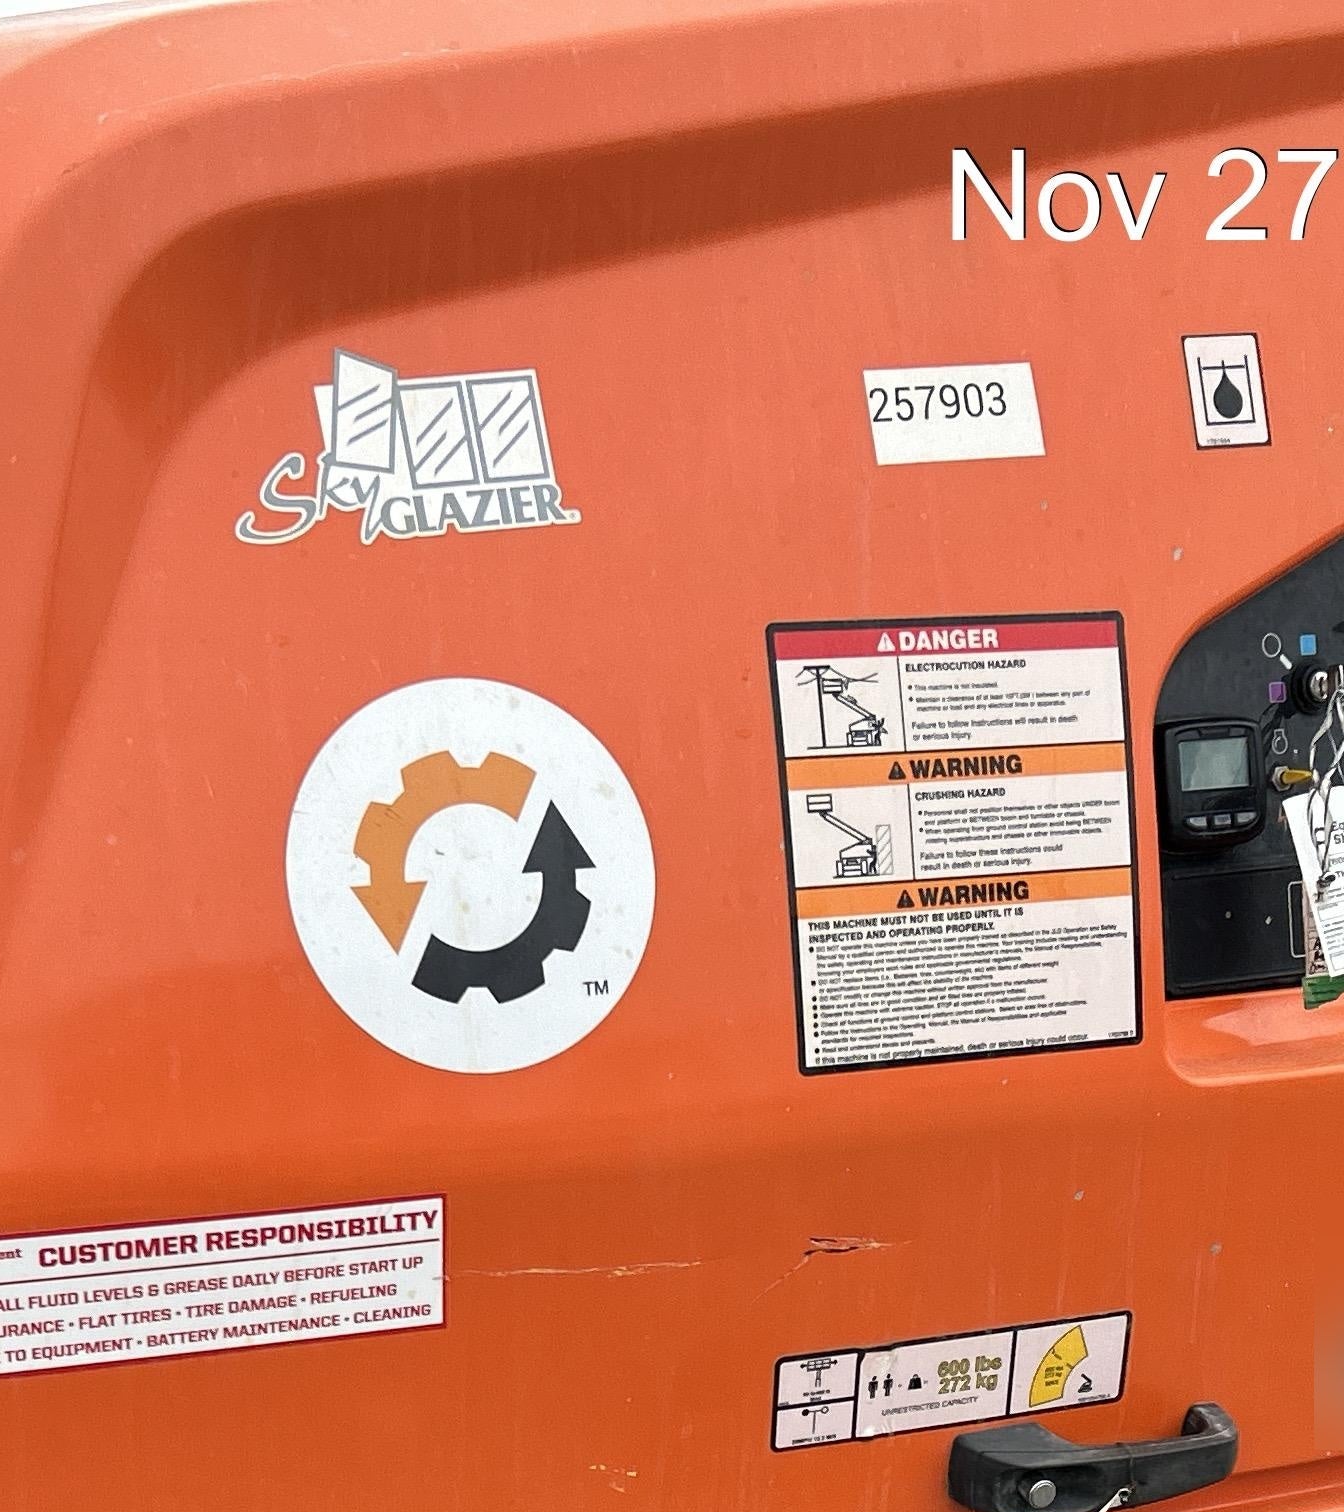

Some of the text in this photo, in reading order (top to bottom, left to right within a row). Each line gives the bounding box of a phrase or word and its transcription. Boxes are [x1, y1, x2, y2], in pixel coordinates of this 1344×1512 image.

[869, 381, 1007, 423] 257903
[899, 628, 999, 652] DANGER
[905, 658, 1025, 672] ELECTROCUTION HAZARD
[910, 755, 1023, 779] WARNING
[914, 785, 1005, 802] CRUSHING HAZARD
[918, 880, 1029, 908] WARNING
[808, 907, 1023, 931] THIS MACHINE MUST NOT BE USED UNTIL IT IS
[808, 921, 994, 944] INSPECTED AND OPERATING PROPERLY.
[38, 1209, 437, 1268] CUSTOMER RESPONSIBILITY
[28, 1291, 78, 1309] FLUID
[83, 1284, 142, 1303] LEVELS
[148, 1283, 158, 1297] &
[164, 1276, 227, 1295] GREASE
[232, 1270, 279, 1288] DAILY
[283, 1264, 344, 1283] BEFORE
[348, 1258, 398, 1276] START
[402, 1256, 423, 1270] UP
[78, 1313, 117, 1330] FLAT
[121, 1307, 171, 1325] TIRES
[185, 1302, 224, 1318] TIRE
[228, 1294, 297, 1314] DAMAGE
[310, 1283, 397, 1304] REFUELING
[5, 1348, 26, 1363] TO
[31, 1337, 133, 1361] EQUIPMENT
[147, 1327, 219, 1348] BATTERY
[223, 1314, 340, 1339] MAINTENANCE
[353, 1303, 431, 1323] CLEANING
[937, 1353, 1001, 1378] 600 lbs
[938, 1370, 998, 1394] 272 kg
[881, 1395, 978, 1416] UNRESTRICTED CAPACITY
